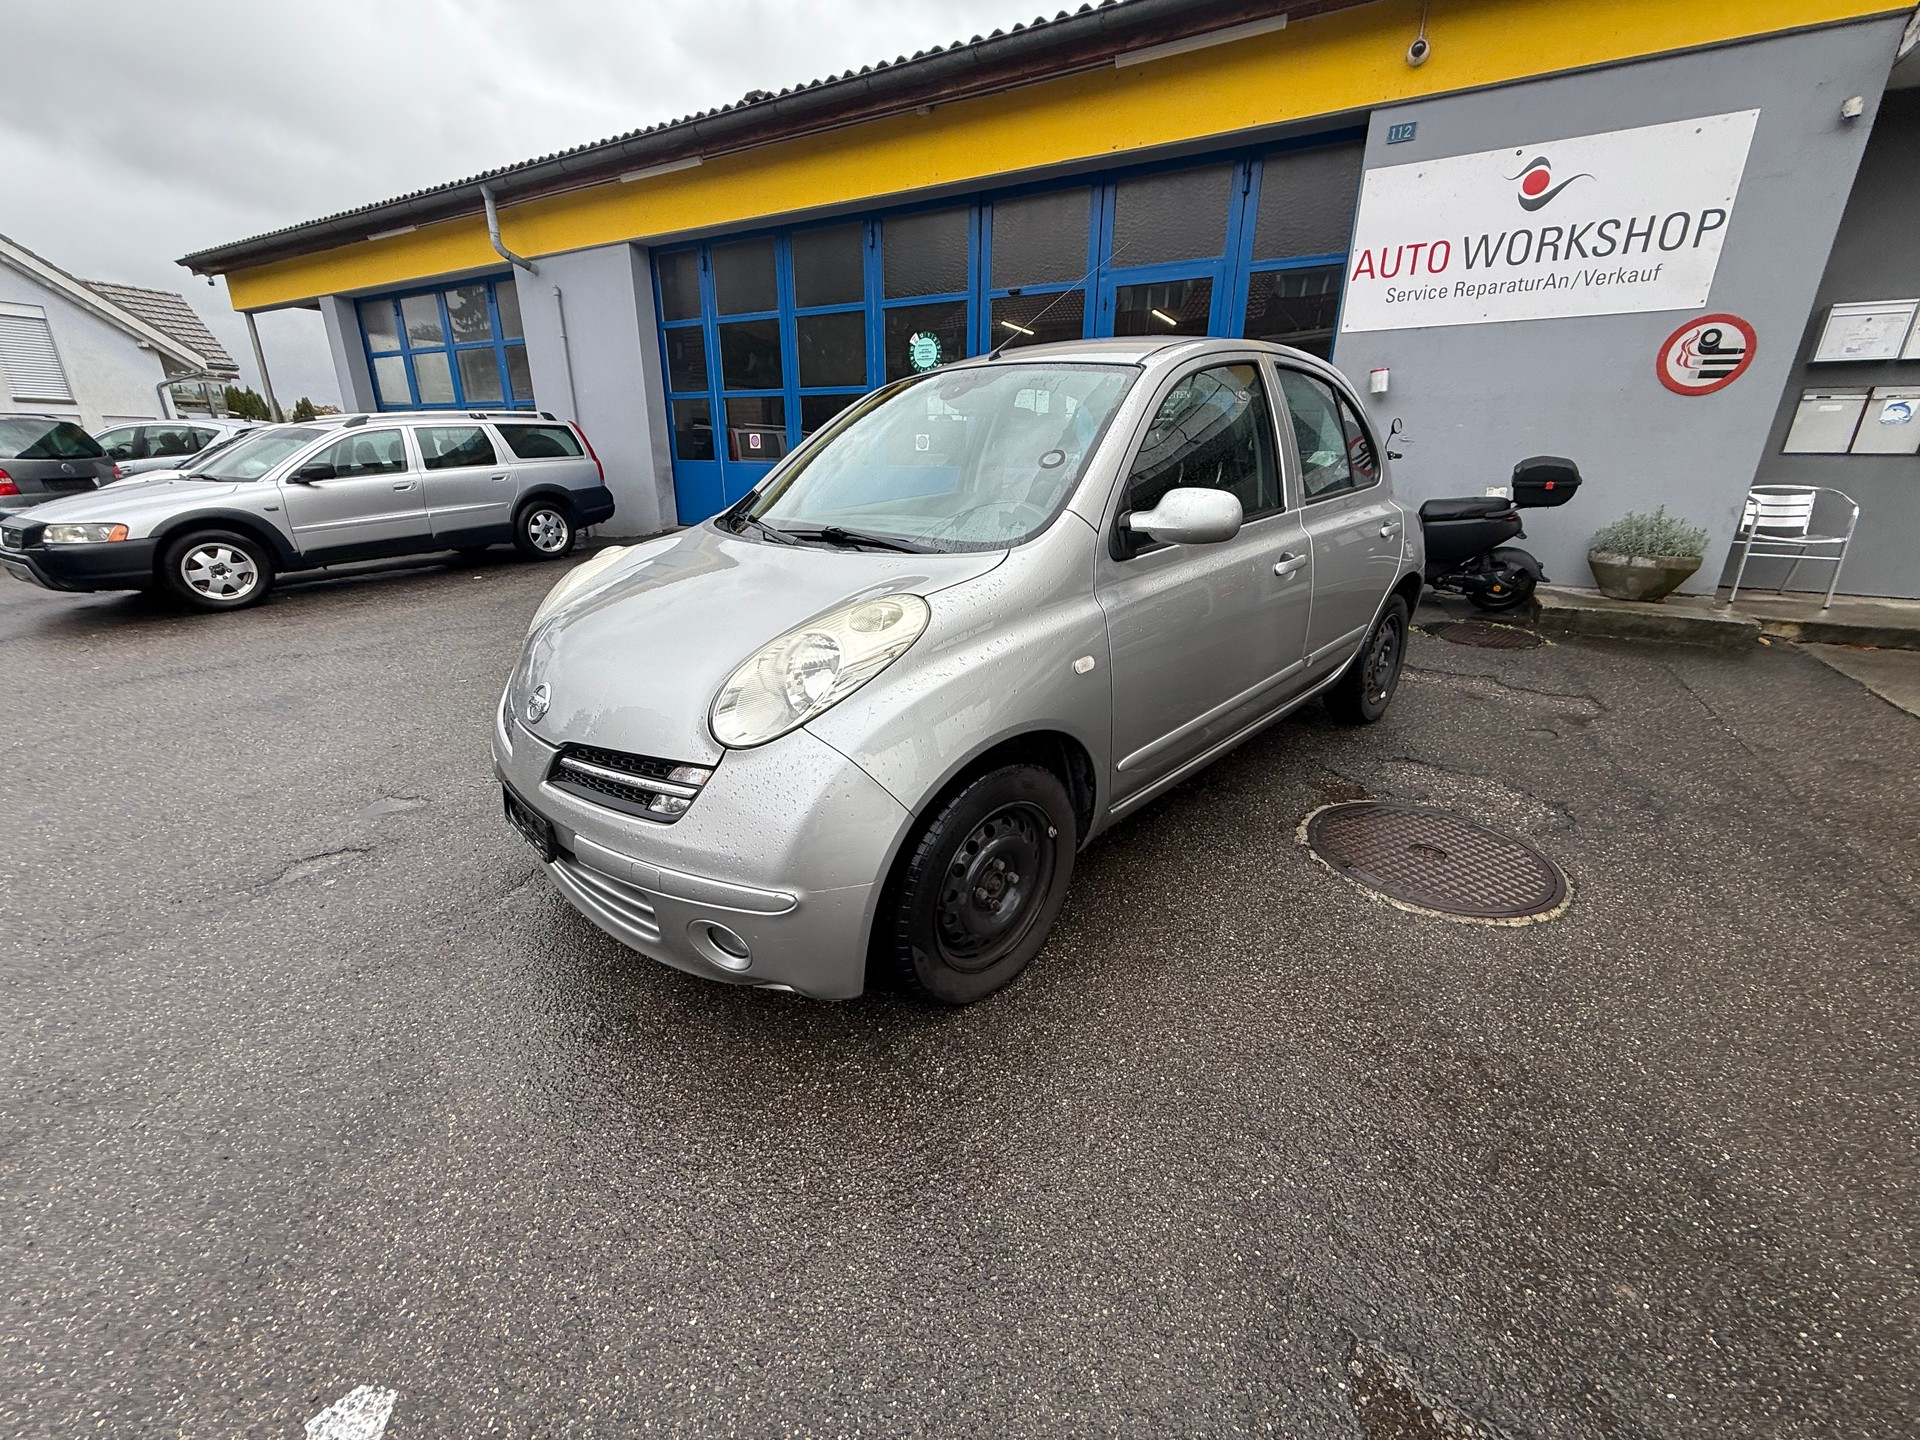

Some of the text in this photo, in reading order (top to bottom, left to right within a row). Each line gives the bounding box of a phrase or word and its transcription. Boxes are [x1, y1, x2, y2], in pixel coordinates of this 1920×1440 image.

[1391, 125, 1412, 140] 112
[1351, 207, 1727, 282] AUTO WORKSHOP
[1385, 284, 1448, 304] Service
